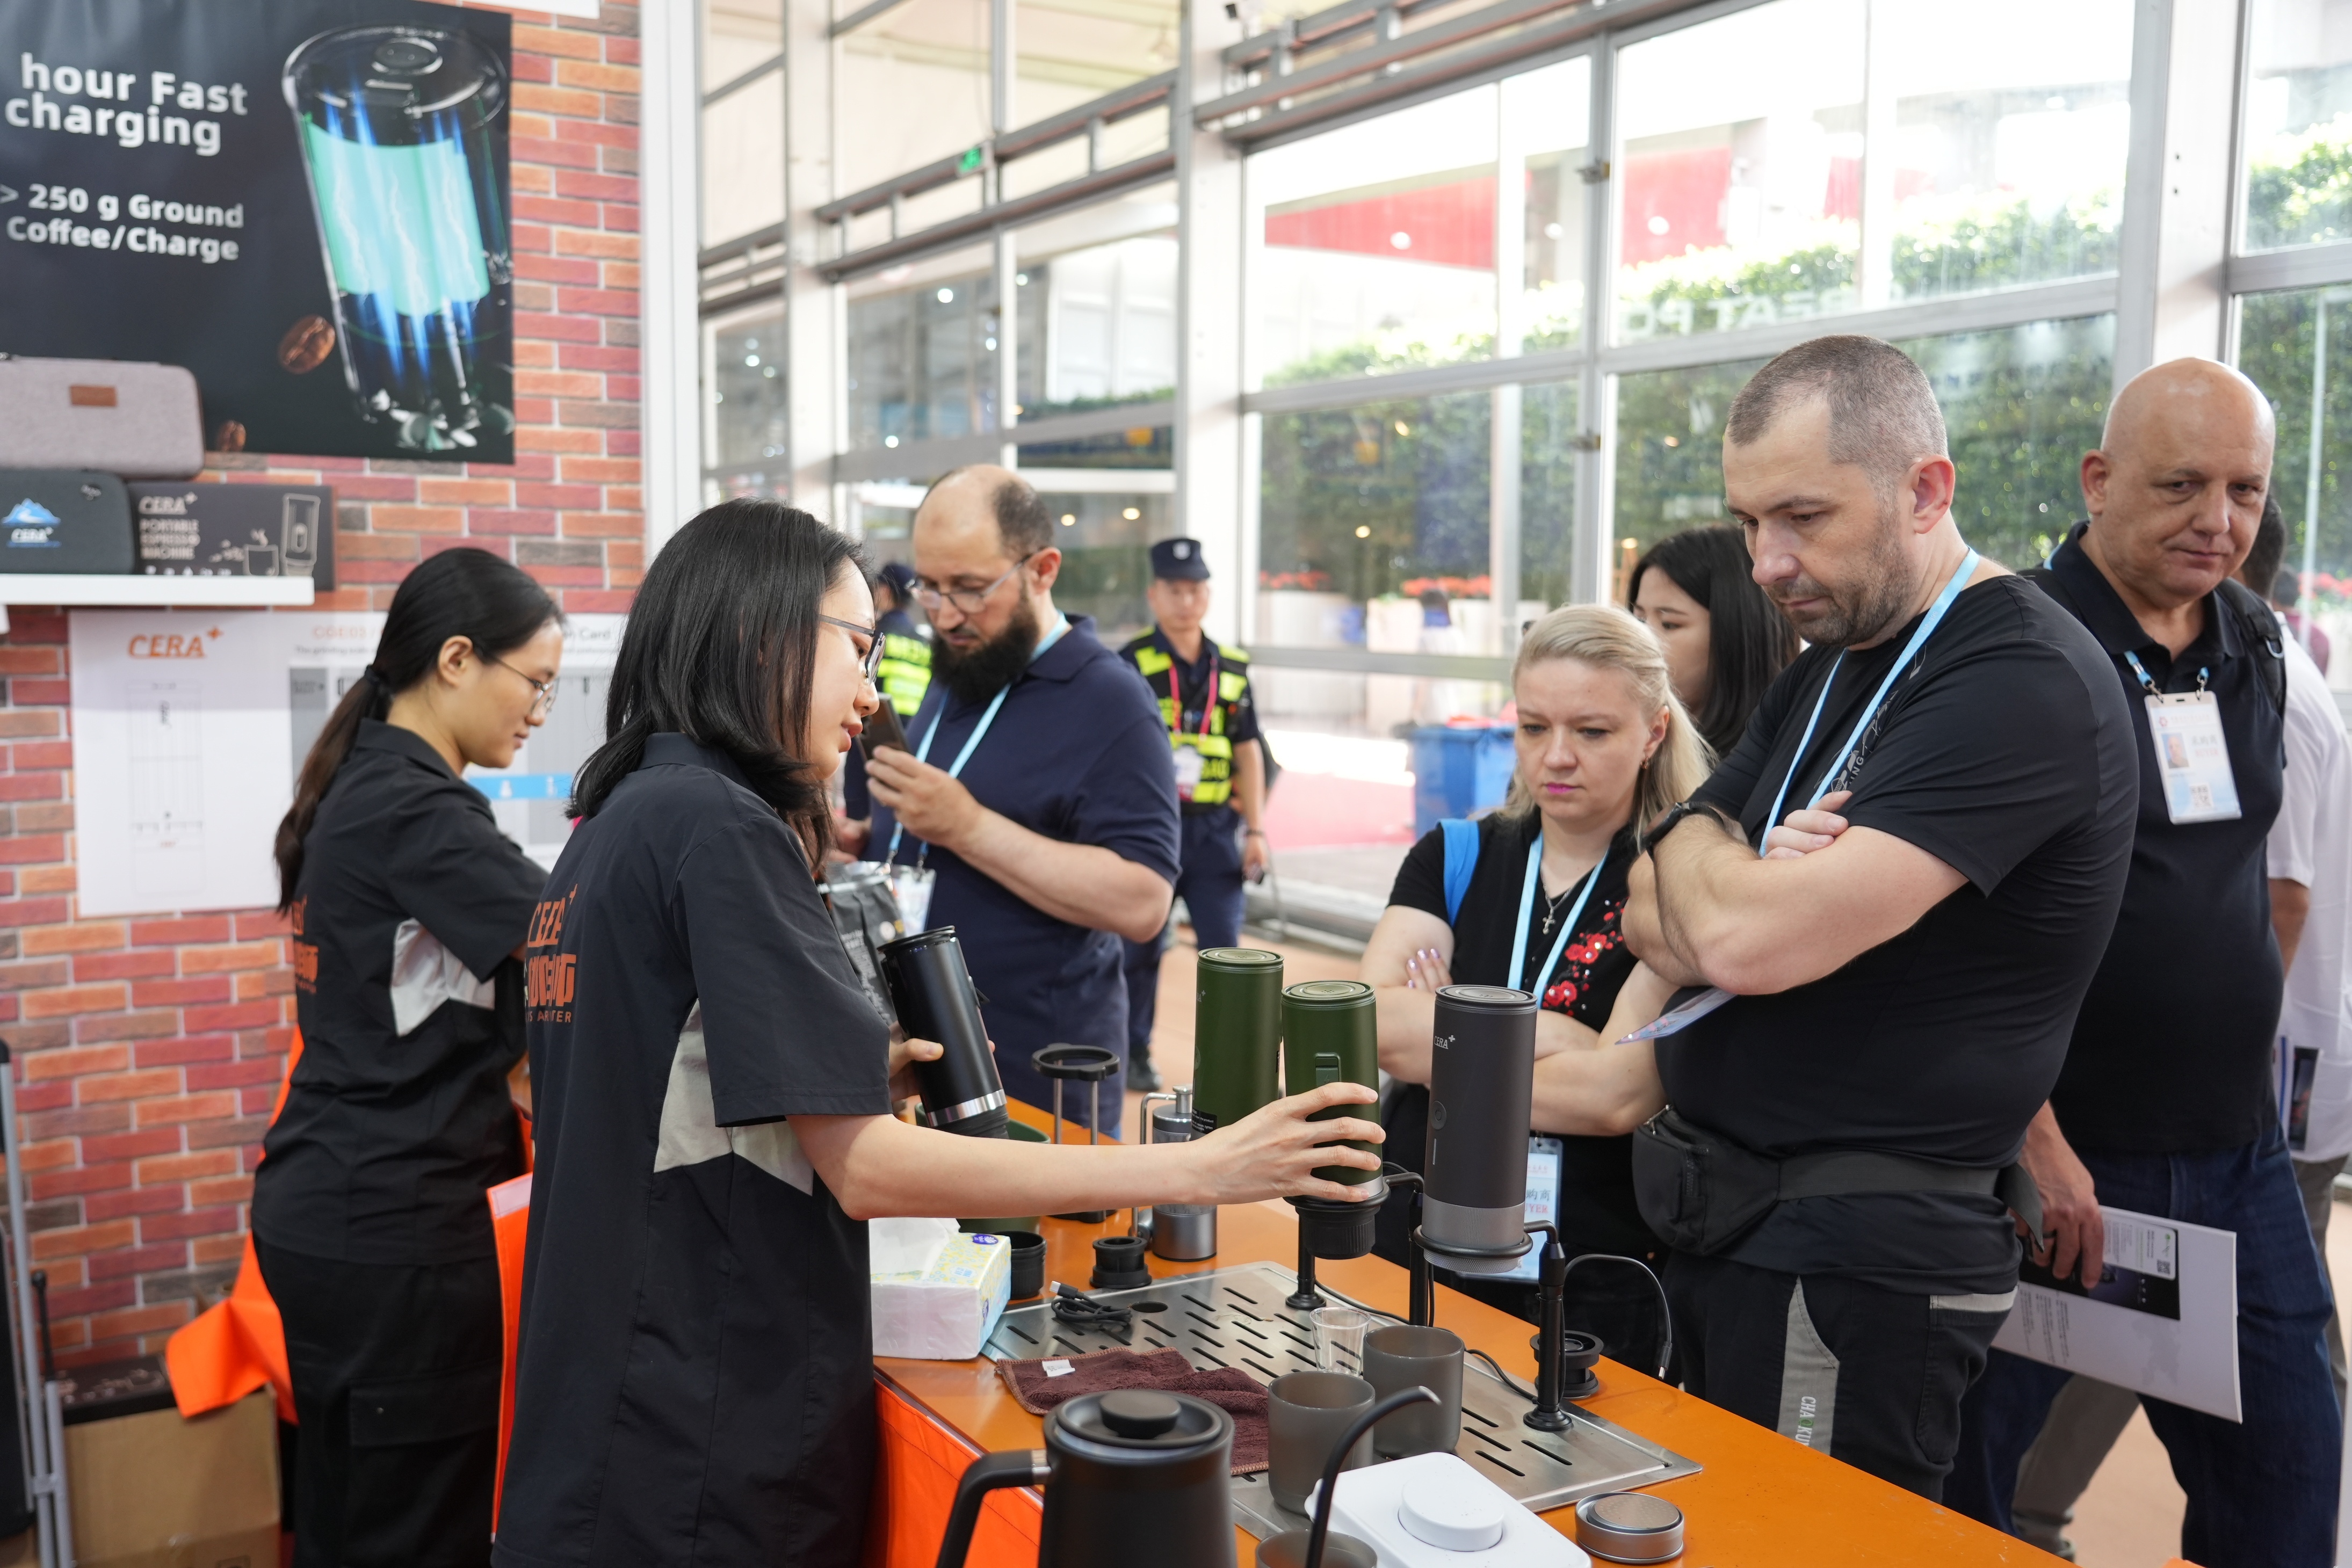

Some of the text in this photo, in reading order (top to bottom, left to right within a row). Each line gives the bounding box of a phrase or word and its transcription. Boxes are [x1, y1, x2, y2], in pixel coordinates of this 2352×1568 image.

[21, 52, 248, 115] hour Fast
[4, 91, 221, 156] charging
[28, 183, 89, 213] 250
[97, 193, 119, 221] g
[128, 193, 244, 229] Ground
[6, 216, 240, 263] Coffee/Charge
[140, 519, 199, 533] PORTABLE
